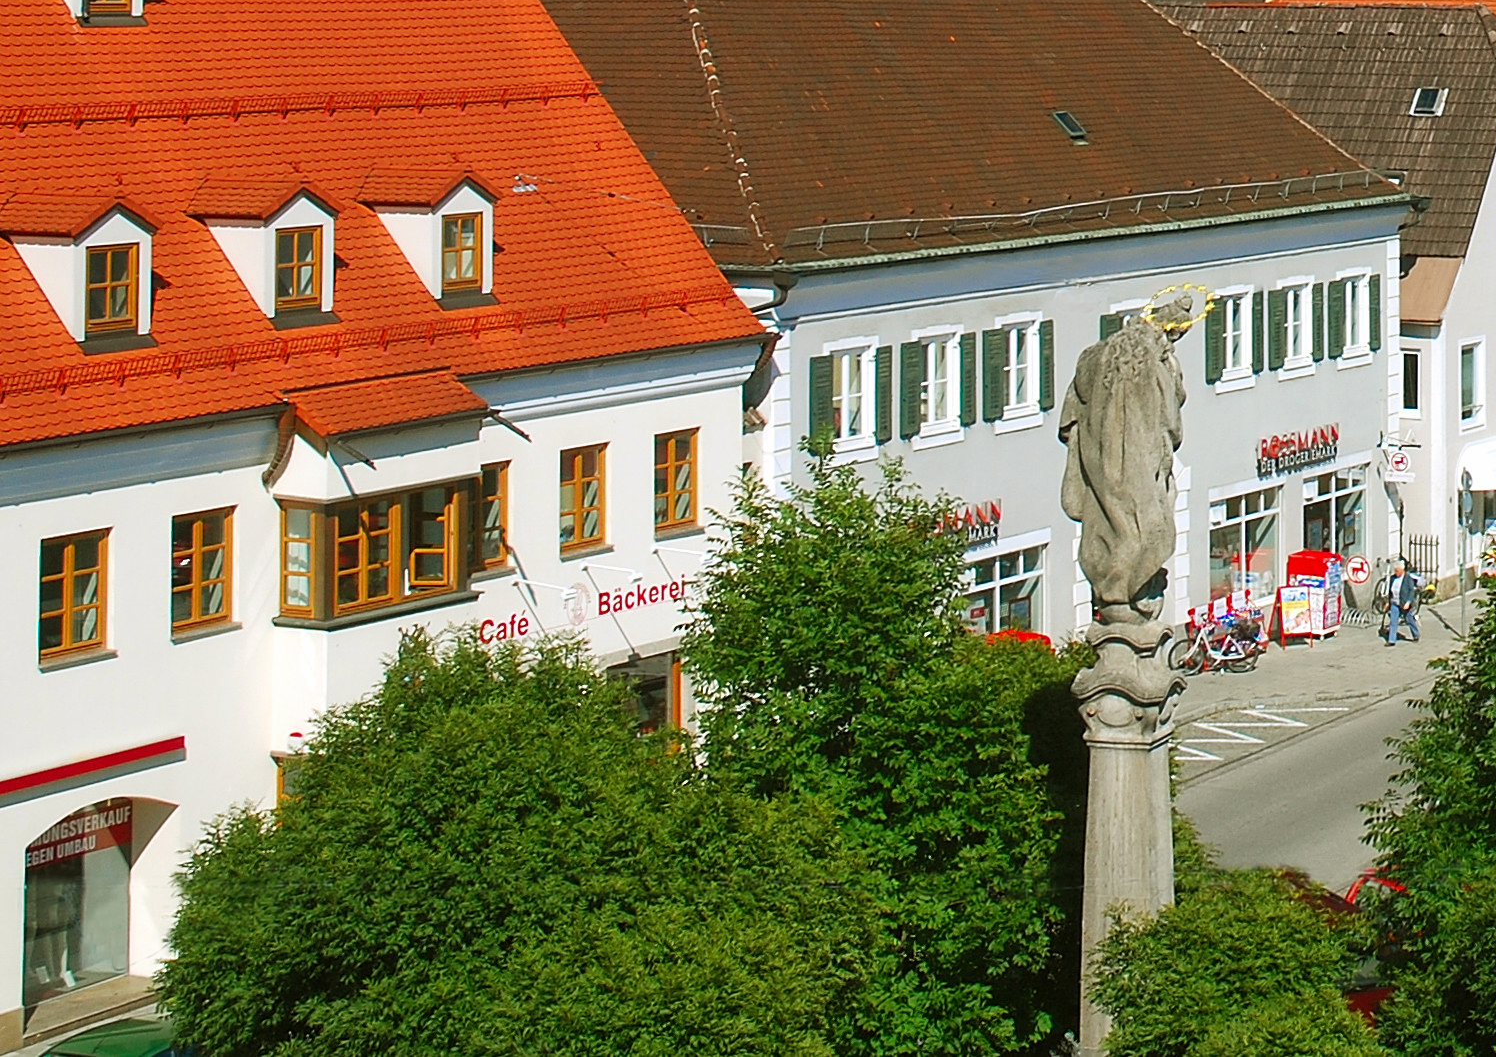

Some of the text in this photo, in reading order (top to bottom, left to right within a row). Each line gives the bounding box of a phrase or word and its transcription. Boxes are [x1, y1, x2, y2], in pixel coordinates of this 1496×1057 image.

[1258, 422, 1339, 460] ROSSMANN
[598, 573, 687, 616] Bäckerei
[479, 610, 529, 645] Café
[31, 806, 131, 846] UNGSVERKAUF
[57, 834, 97, 859] UMBAU
